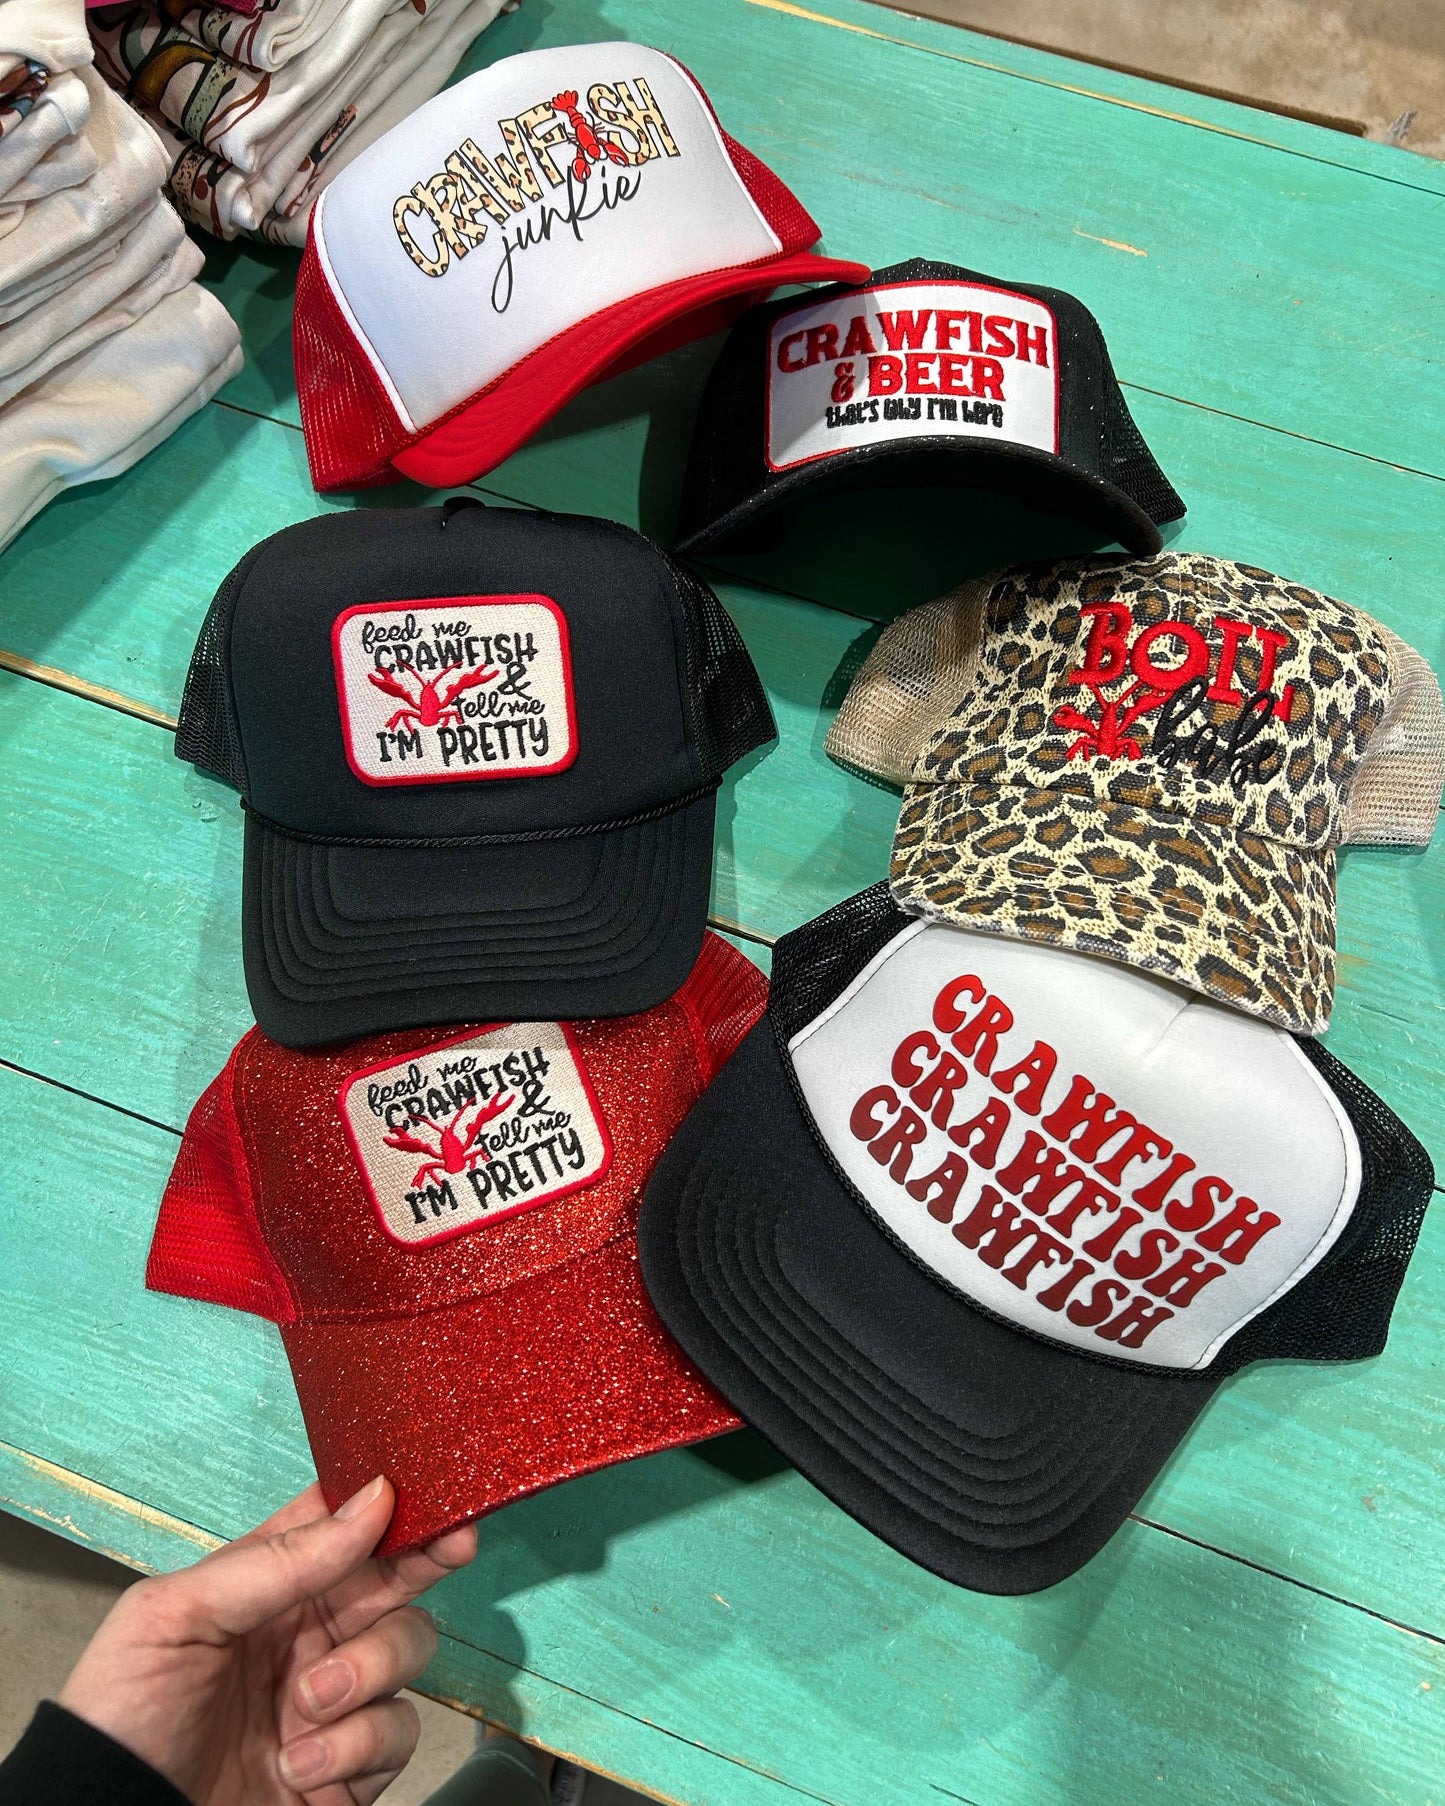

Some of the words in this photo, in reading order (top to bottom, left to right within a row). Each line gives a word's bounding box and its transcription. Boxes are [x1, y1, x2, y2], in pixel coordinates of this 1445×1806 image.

[491, 165, 642, 314] junkie
[777, 309, 1049, 374] CRAWFISH
[831, 361, 855, 403] &
[867, 352, 1006, 402] BEER
[362, 613, 423, 654] feed
[432, 620, 472, 639] me
[374, 632, 539, 675] CRAWFISH
[1068, 601, 1296, 723] BOIL
[498, 661, 533, 700] &
[507, 699, 546, 717] me
[376, 728, 424, 763] I'M
[437, 717, 550, 768] PRETTY
[1151, 674, 1282, 787] babe
[367, 1063, 429, 1117] feed
[436, 1055, 478, 1082] me
[384, 1046, 551, 1131] CRAWFISH
[517, 1079, 556, 1117] &
[530, 1111, 572, 1138] me
[932, 973, 1281, 1266] CRAWFISH
[405, 1178, 460, 1225] I'M
[466, 1127, 587, 1210] PRETTY
[891, 1030, 1227, 1309] CRAWFISH
[849, 1084, 1175, 1349] CRAWFISH
